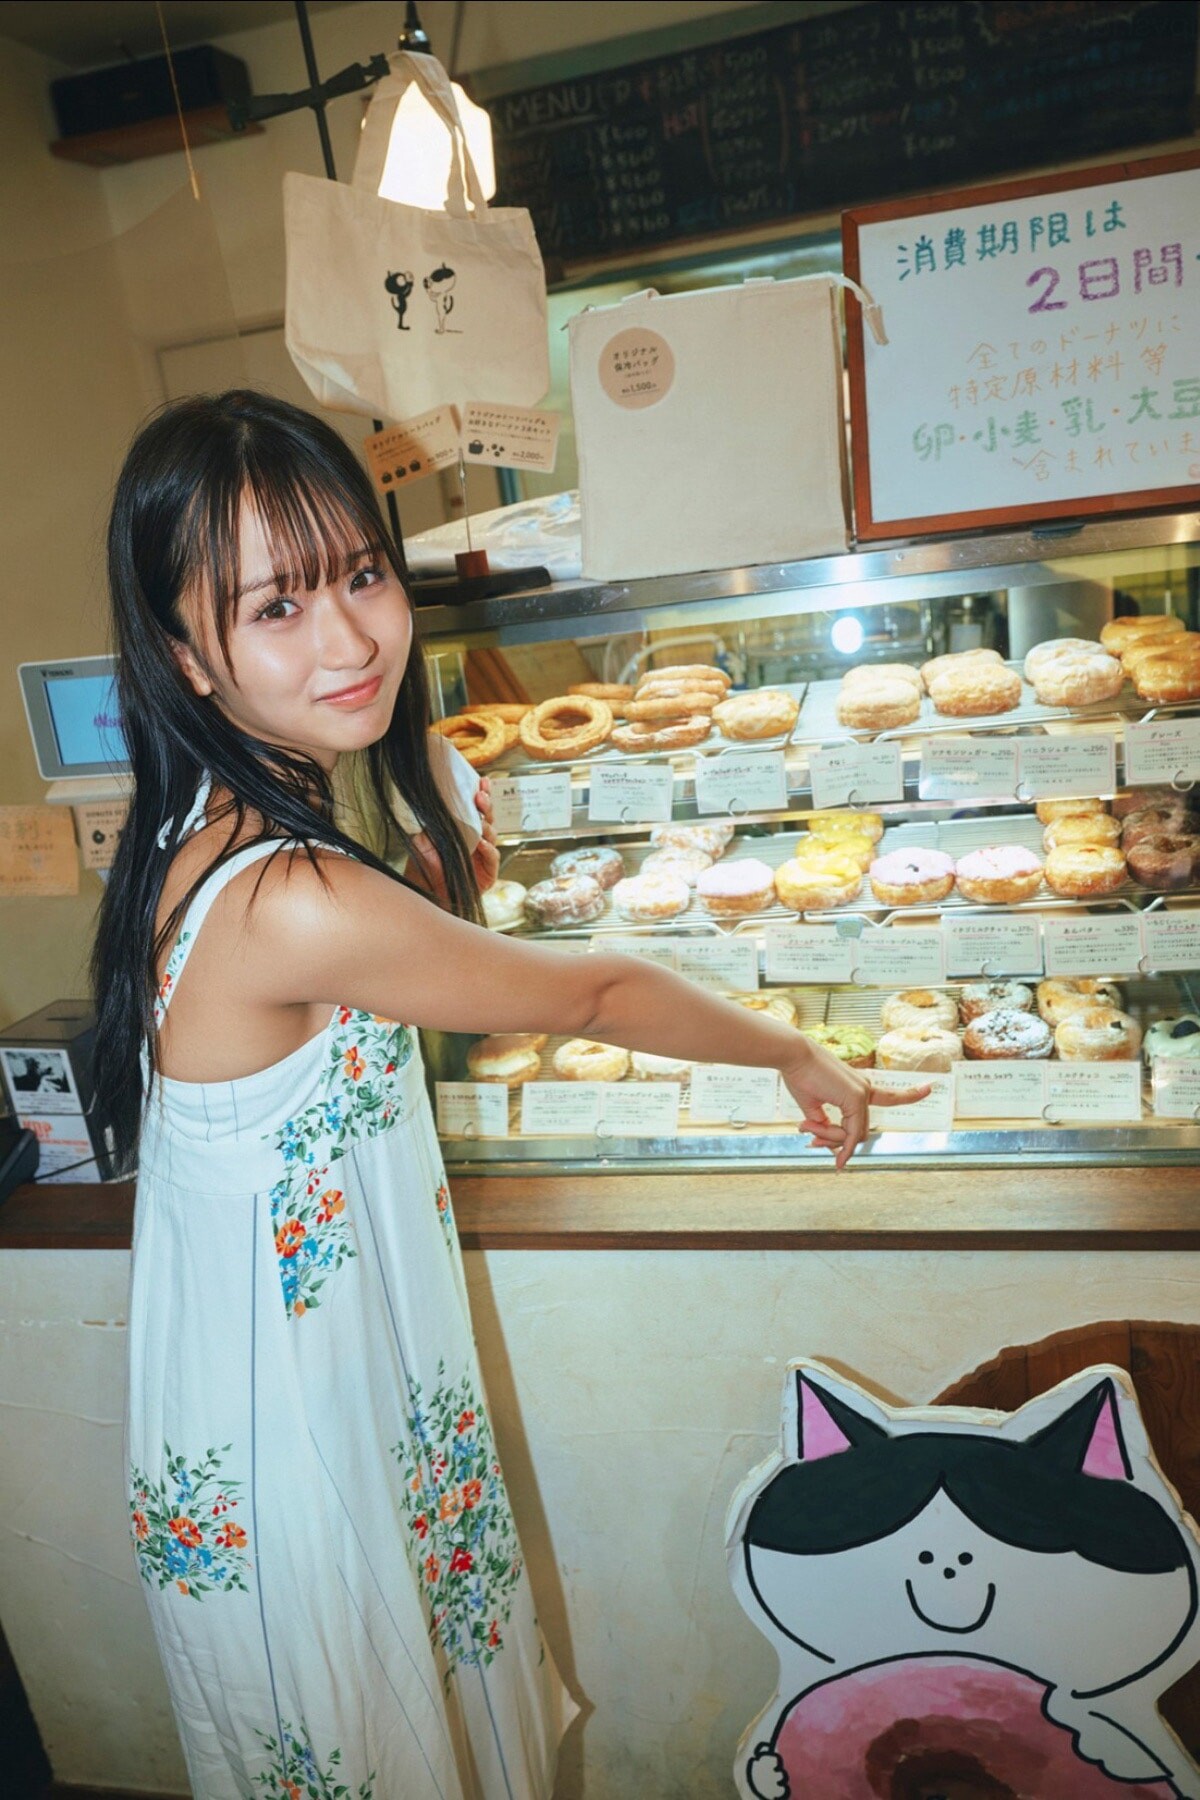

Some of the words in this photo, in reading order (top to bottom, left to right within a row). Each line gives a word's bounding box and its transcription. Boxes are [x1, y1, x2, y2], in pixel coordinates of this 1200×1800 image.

[505, 84, 593, 131] MENU
[896, 200, 1128, 281] 消費期限は
[1025, 242, 1200, 315] 2日間
[965, 313, 1185, 372] 全てのドーナツに
[947, 343, 1170, 410] 特定原材料等
